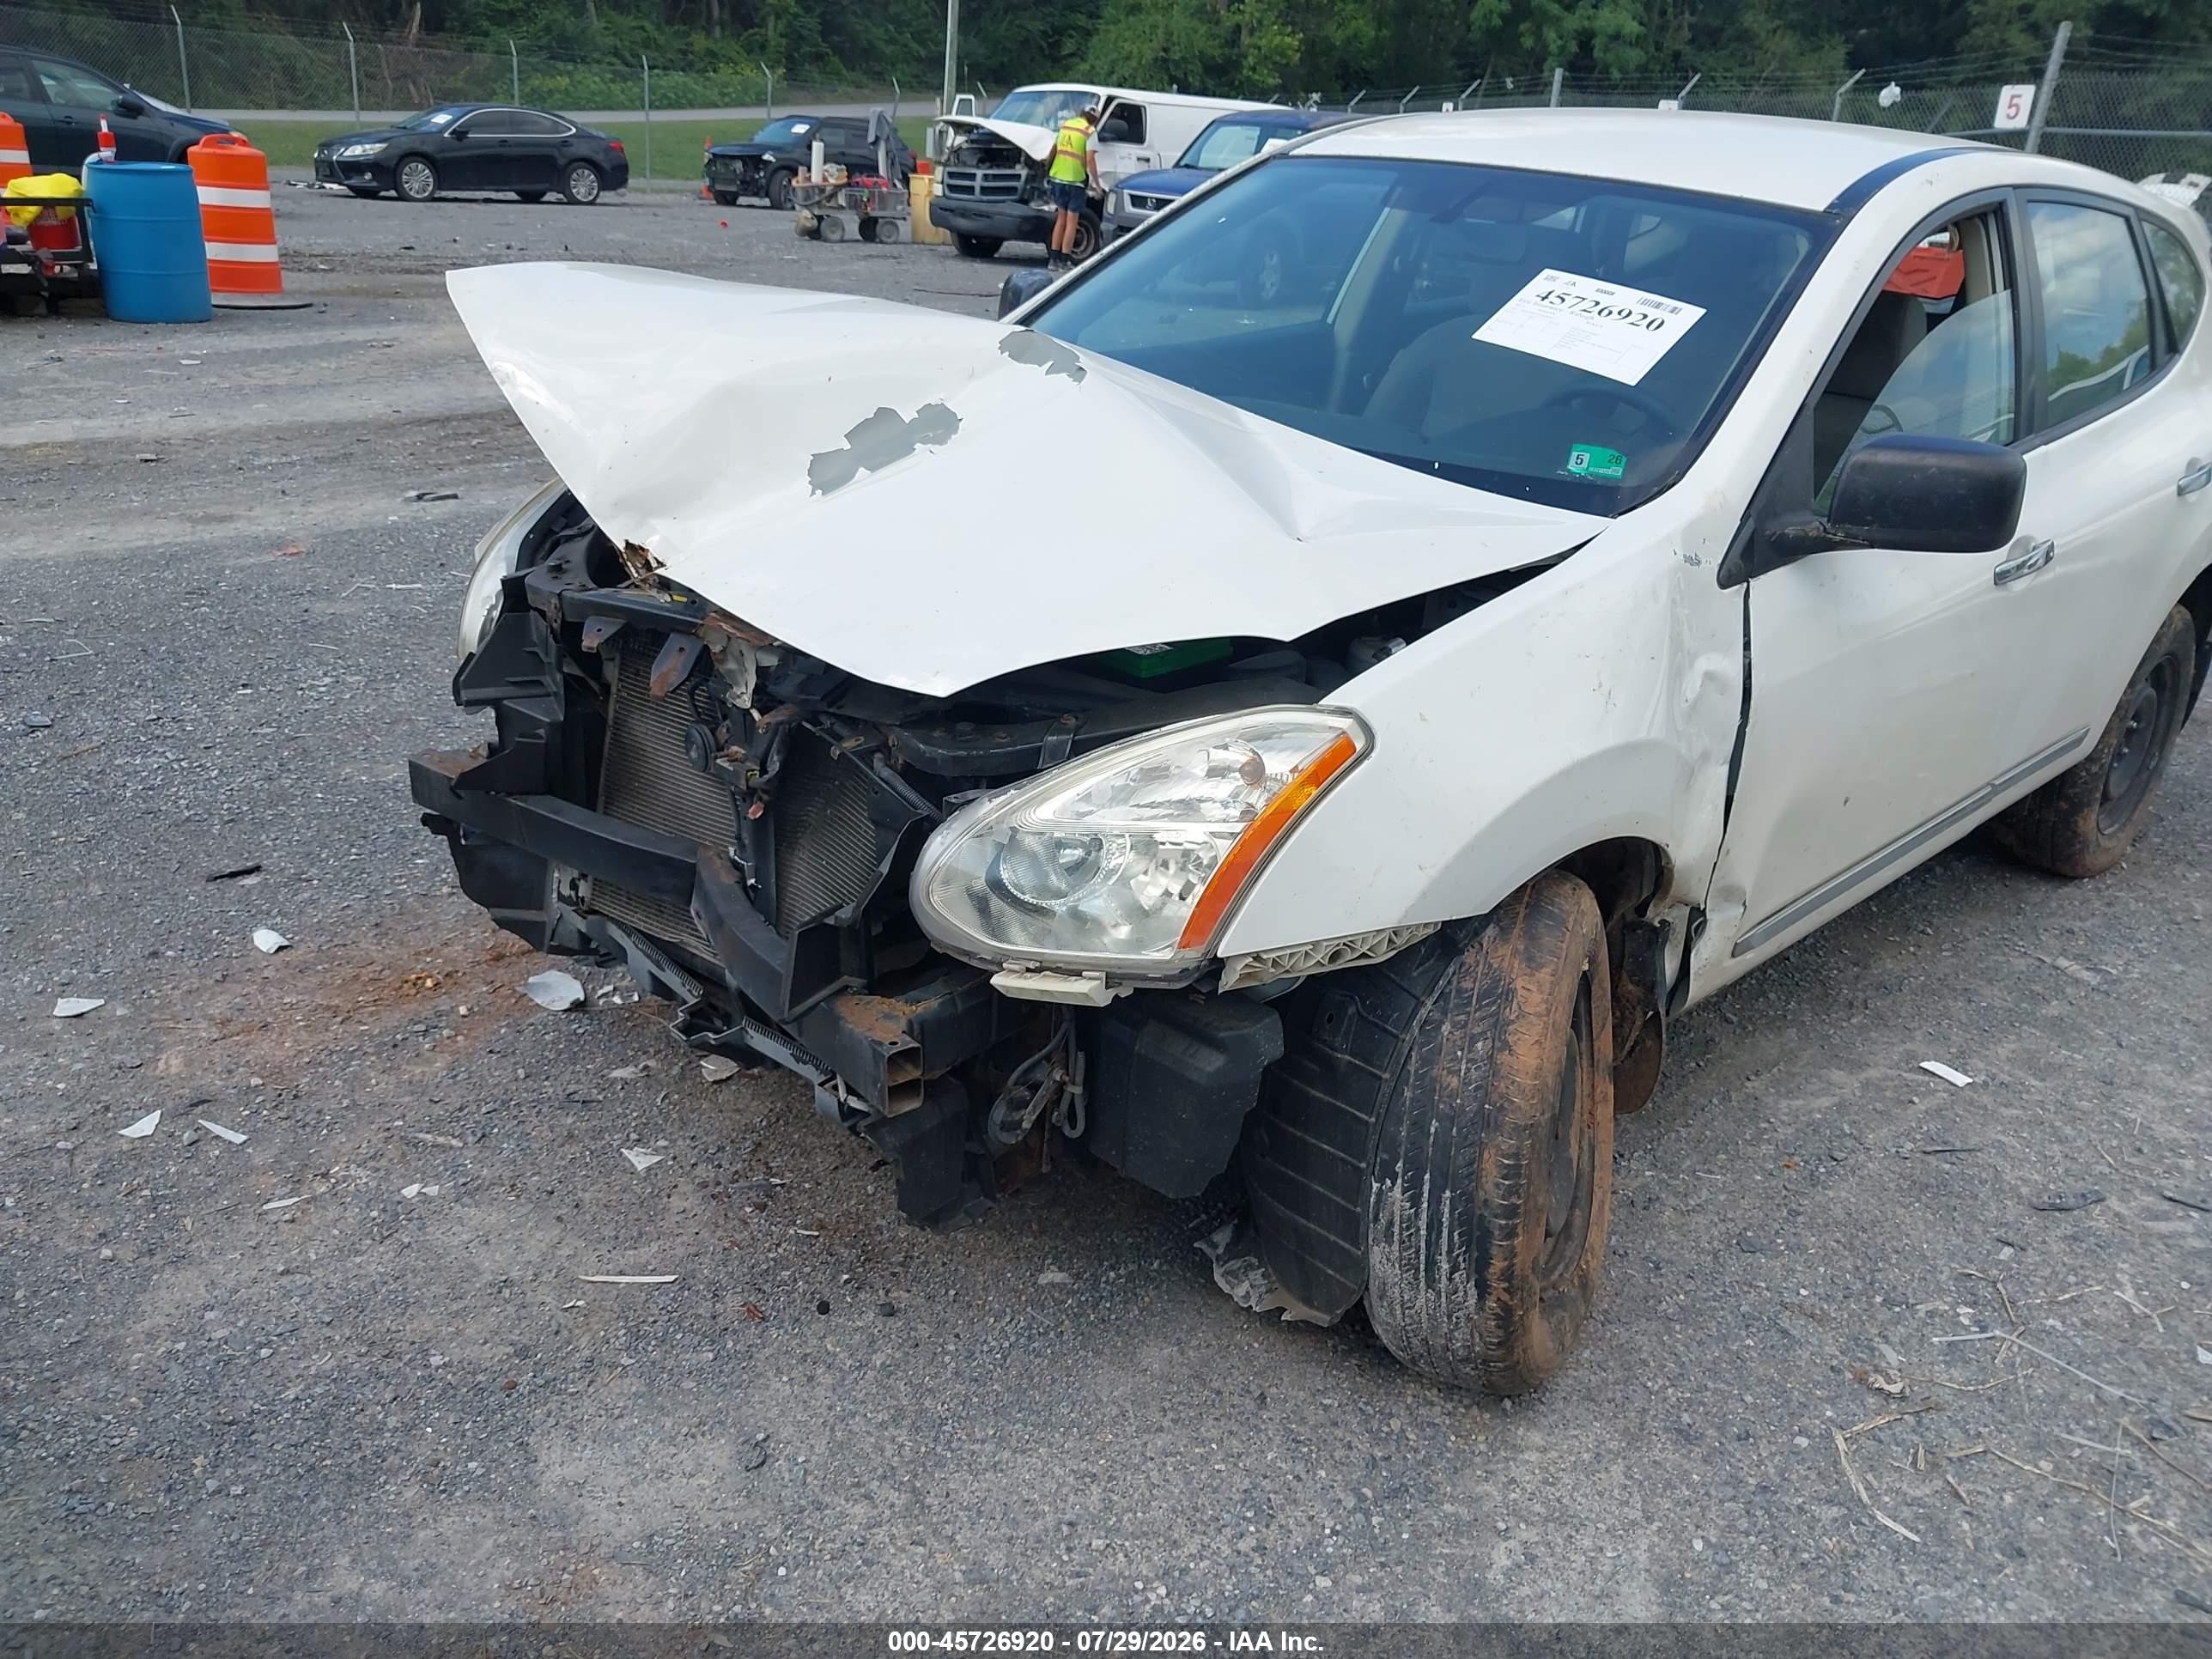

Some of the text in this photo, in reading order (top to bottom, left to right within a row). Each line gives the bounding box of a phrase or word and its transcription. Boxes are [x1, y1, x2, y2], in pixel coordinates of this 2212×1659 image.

[2006, 94, 2023, 120] 5
[1534, 289, 1666, 331] 45726920
[1575, 453, 1585, 465] 5
